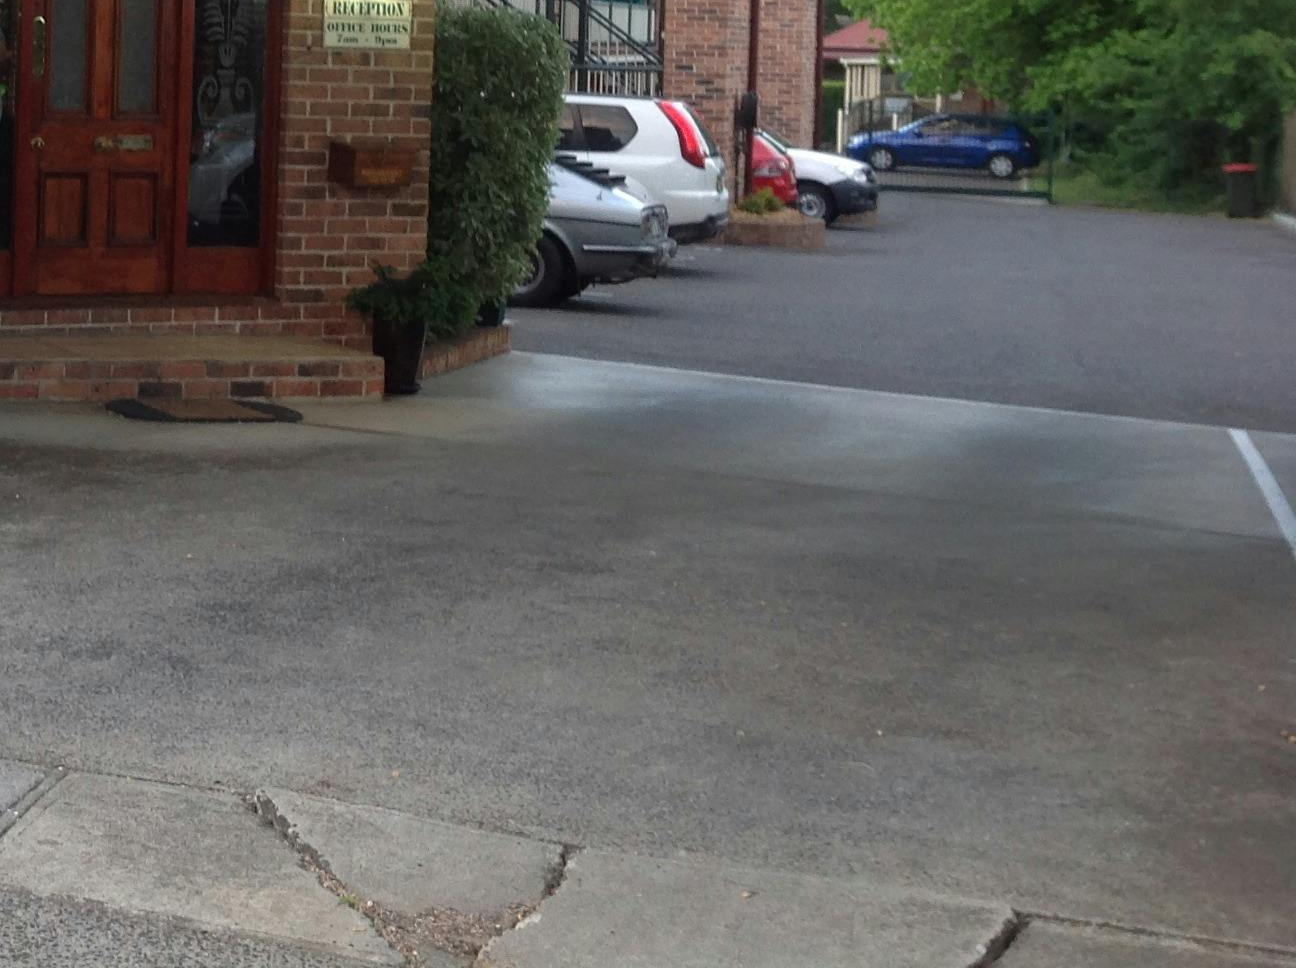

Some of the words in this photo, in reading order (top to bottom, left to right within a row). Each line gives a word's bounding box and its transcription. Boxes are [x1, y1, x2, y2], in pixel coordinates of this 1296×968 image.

[332, 0, 404, 17] RECEPTION
[326, 22, 364, 32] OFFICE
[371, 23, 409, 34] HOURS
